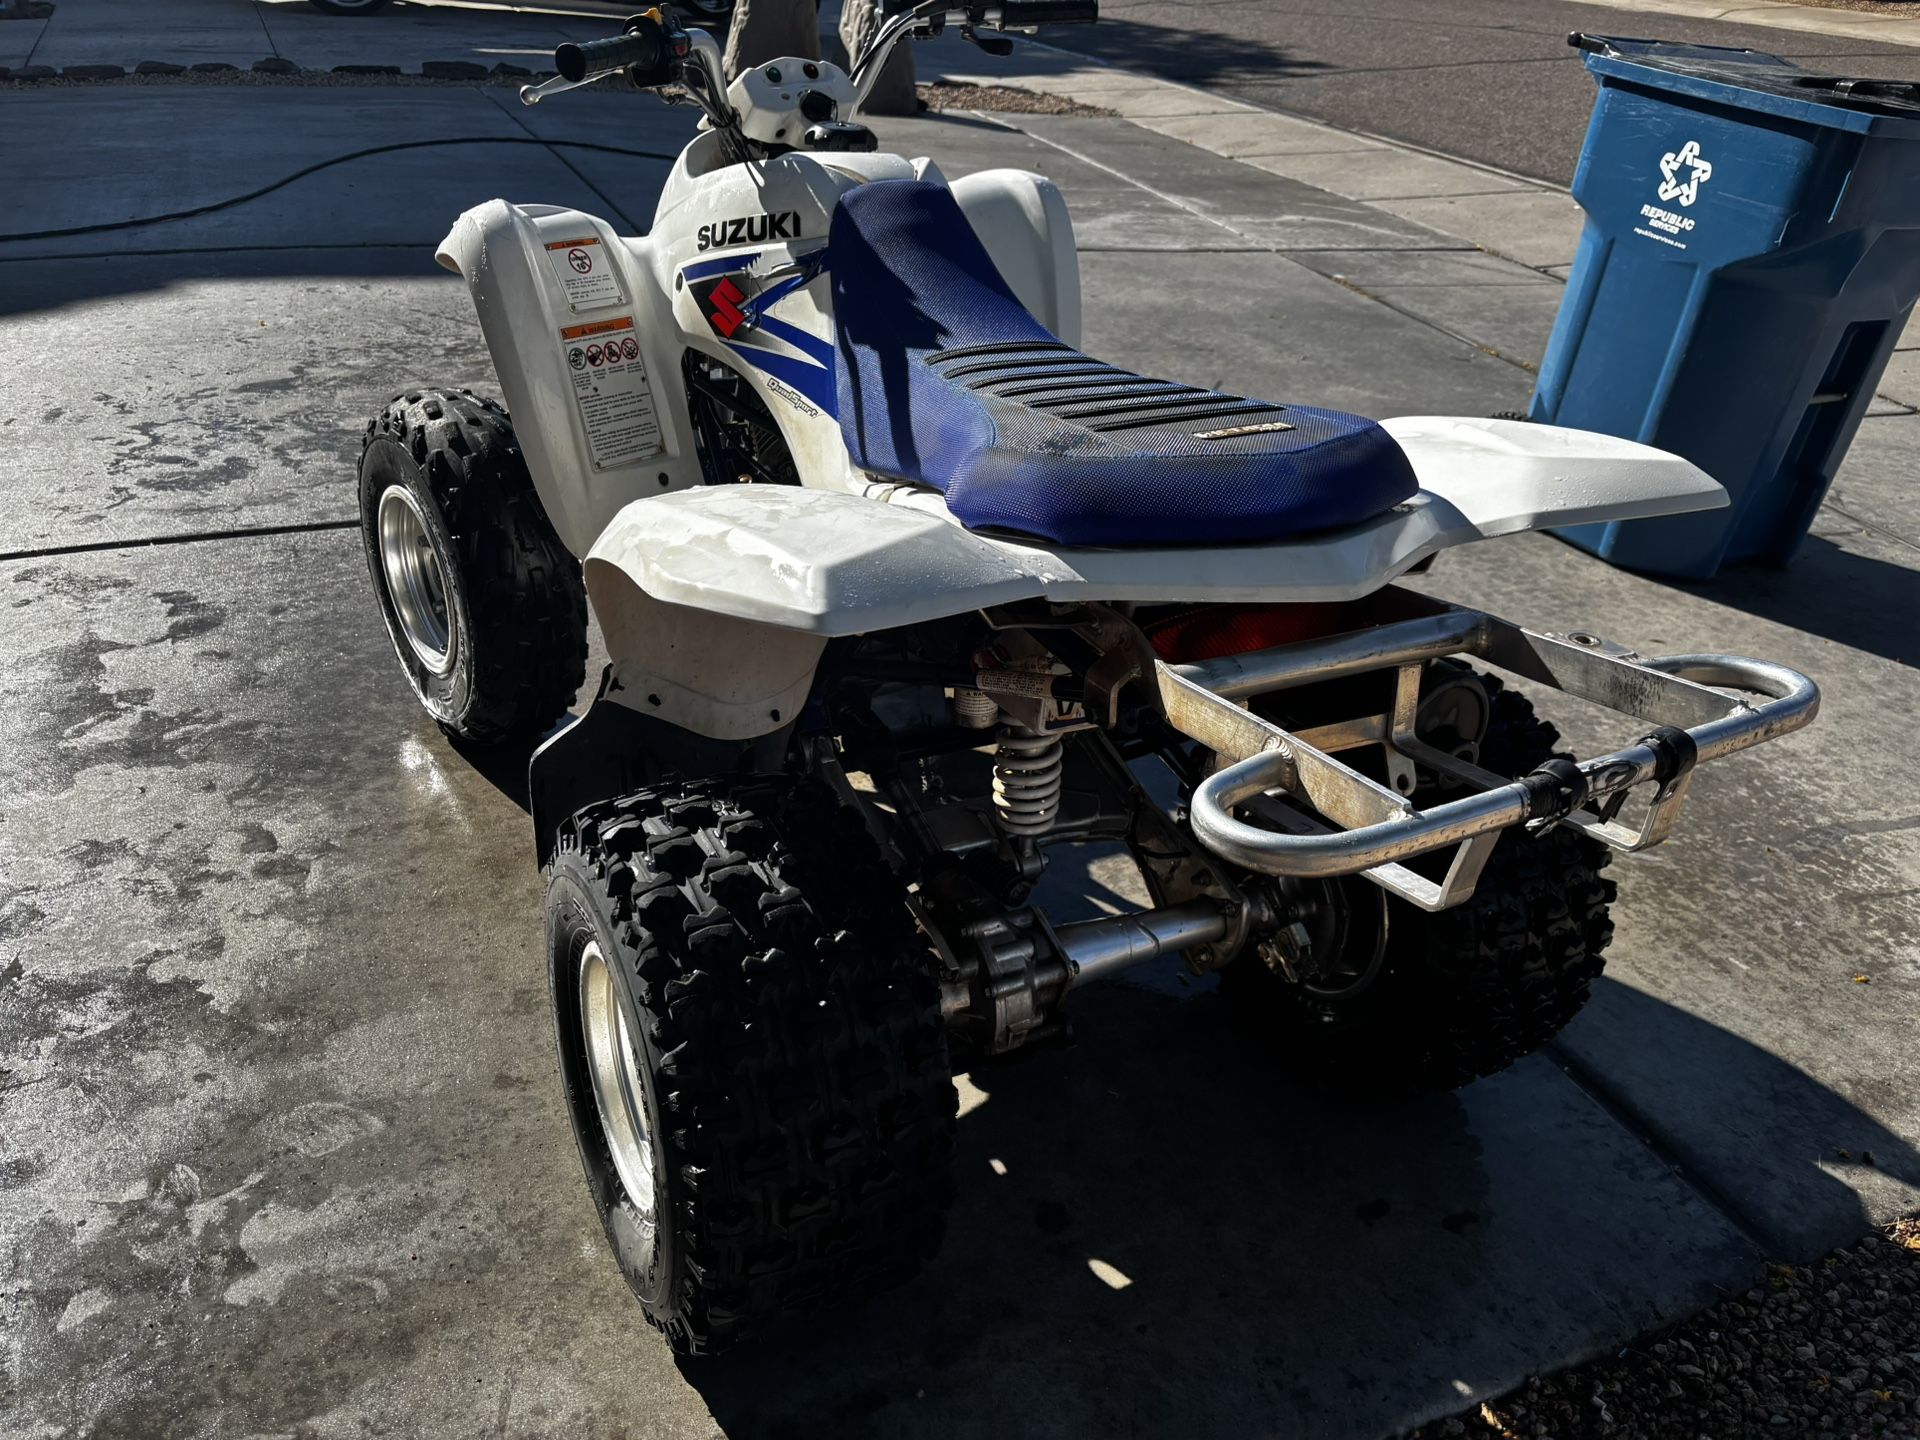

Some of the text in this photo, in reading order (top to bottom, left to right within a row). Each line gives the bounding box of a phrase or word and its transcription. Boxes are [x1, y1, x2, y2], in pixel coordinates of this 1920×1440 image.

[697, 211, 801, 251] SUZUKI
[1640, 204, 1695, 231] REPUBLIC
[767, 378, 818, 417] QuadSport
